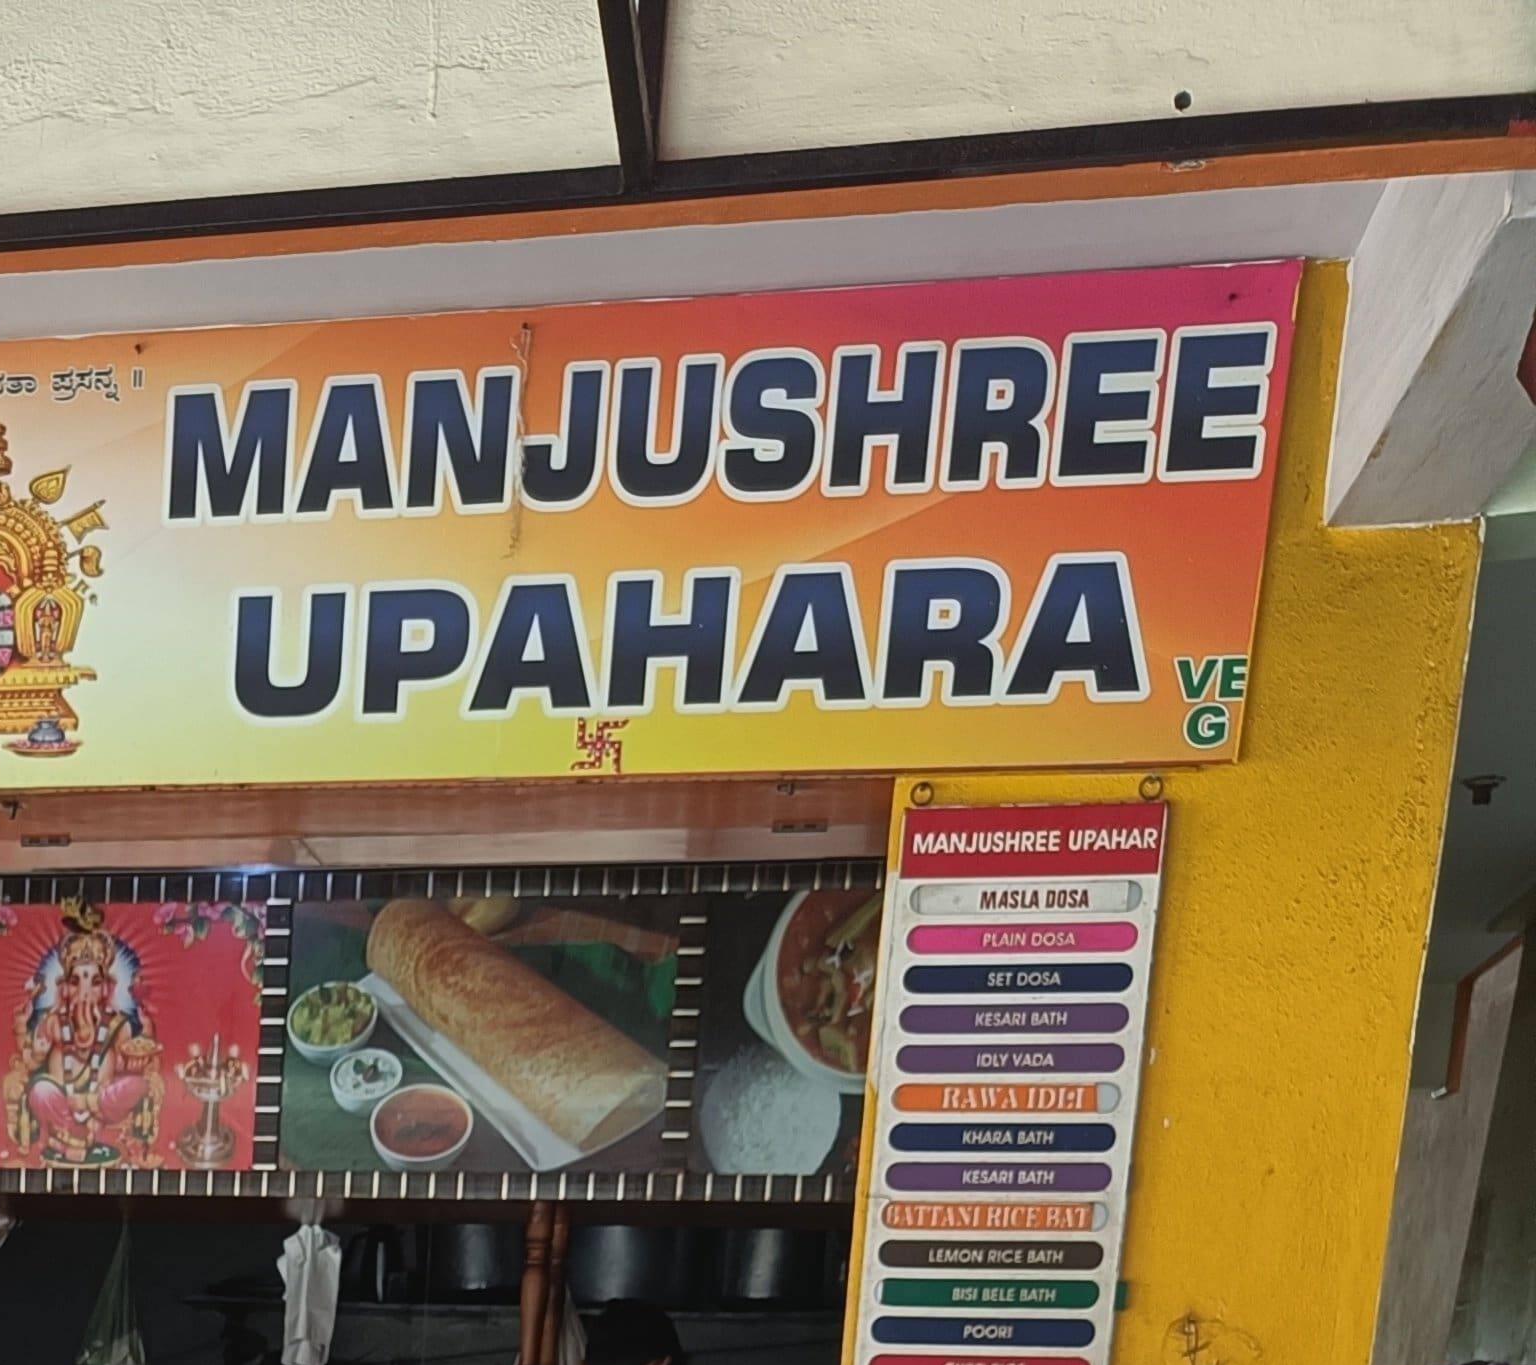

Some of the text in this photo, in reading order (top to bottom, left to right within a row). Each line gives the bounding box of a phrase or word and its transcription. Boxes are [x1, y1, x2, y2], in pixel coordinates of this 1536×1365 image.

[52, 365, 120, 402] ಪ್ರಸನ್ನ
[163, 324, 1274, 523] MANJUSHREE
[231, 553, 1150, 720] UPAHARA
[913, 828, 1158, 855] MANJUSHREE UPAHAR
[979, 889, 1090, 911] MASLA DOSA
[982, 931, 1076, 948] PLAIN DOSA
[987, 971, 1061, 987] SET DOSA
[975, 1011, 1068, 1027] KESARI BATH
[976, 1052, 1055, 1068] IDLY VADA
[941, 1086, 1020, 1110] RAWA
[962, 1130, 1055, 1145] KHARA BATH
[962, 1170, 1055, 1185] KESARI BATH
[987, 1205, 1042, 1228] RICE
[928, 1248, 1064, 1264] LEMON RICE BATH
[951, 1286, 1056, 1303] BISI BELE BATH
[963, 1324, 1013, 1339] POORI
